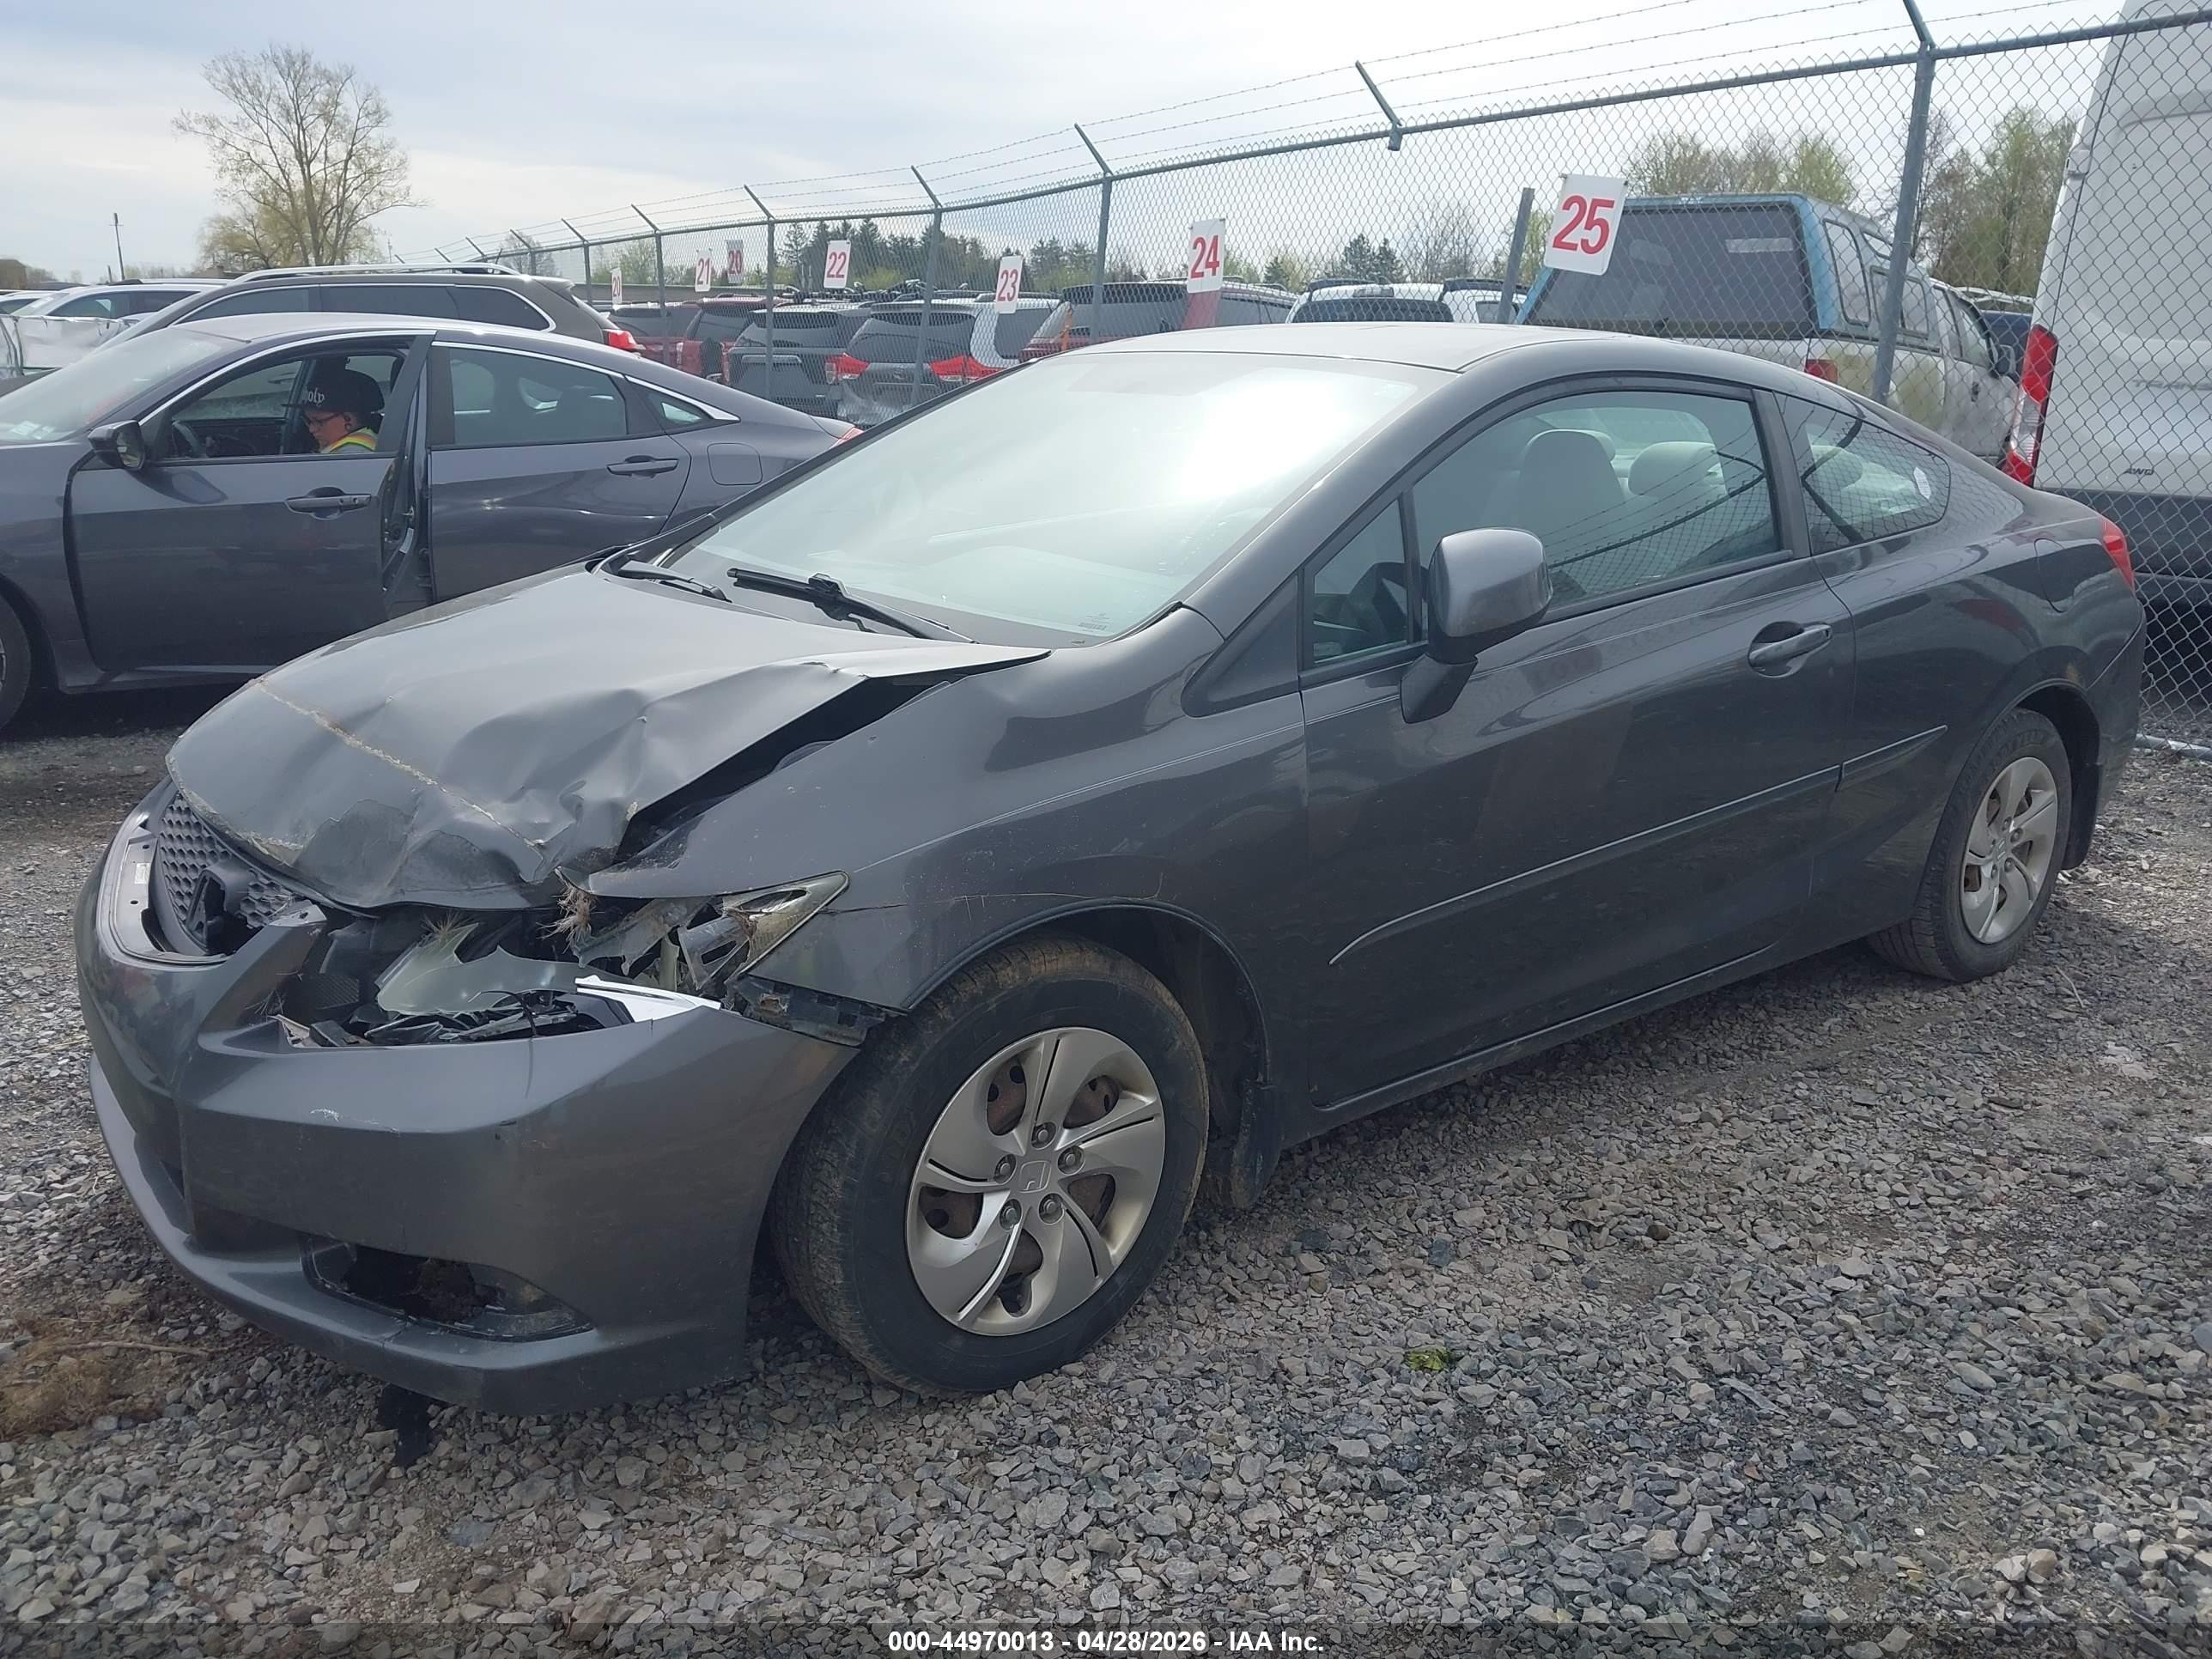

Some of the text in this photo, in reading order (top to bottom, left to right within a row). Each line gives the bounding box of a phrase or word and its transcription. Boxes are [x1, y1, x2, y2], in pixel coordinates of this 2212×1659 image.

[1552, 195, 1614, 254] 25
[728, 250, 743, 275] 20
[826, 252, 847, 279] 22
[1190, 234, 1219, 278] 24
[696, 258, 711, 285] 21
[997, 269, 1018, 301] 23
[612, 276, 621, 297] 20
